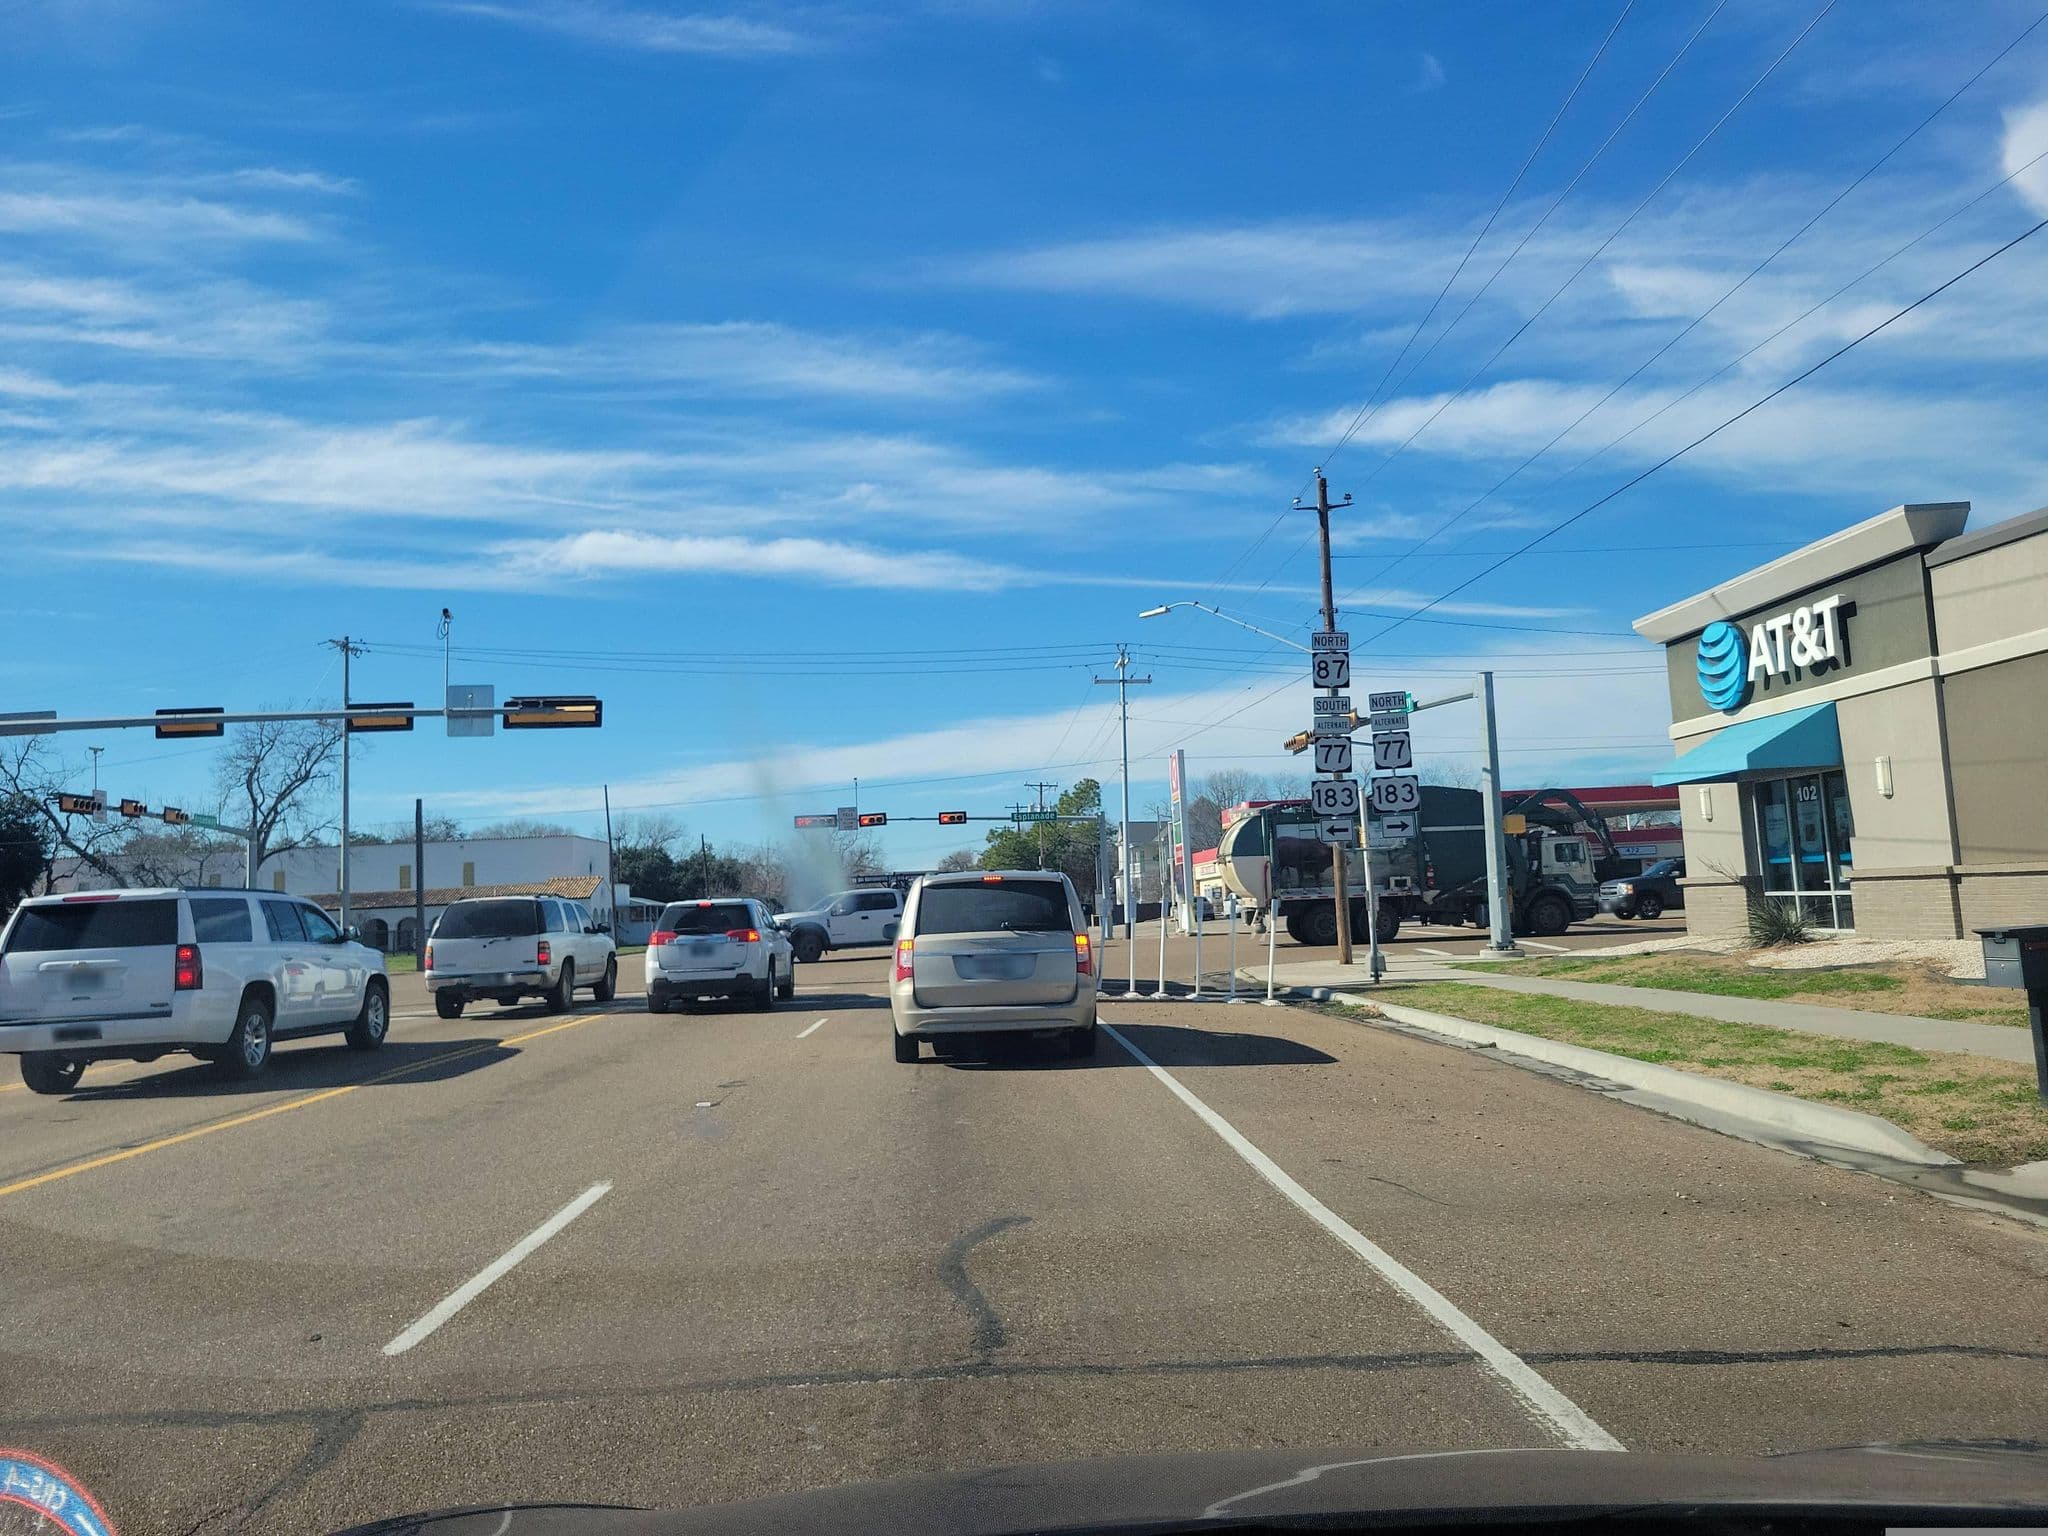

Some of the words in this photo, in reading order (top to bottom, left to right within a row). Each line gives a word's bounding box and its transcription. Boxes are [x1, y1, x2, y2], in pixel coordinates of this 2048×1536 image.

[1313, 637, 1347, 647] NORTH
[1747, 594, 1849, 683] AT&T
[1317, 660, 1346, 679] 87
[1316, 700, 1348, 711] SOUTH
[1371, 697, 1404, 708] NORTH
[1317, 721, 1349, 730] ALTERNATE
[1374, 716, 1406, 727] ALTERNATE
[1319, 744, 1347, 764] 77
[1378, 740, 1405, 760] 77
[1316, 787, 1354, 808] 183
[1375, 783, 1414, 804] 183
[1796, 785, 1818, 803] 102
[1013, 812, 1055, 821] Esplanade
